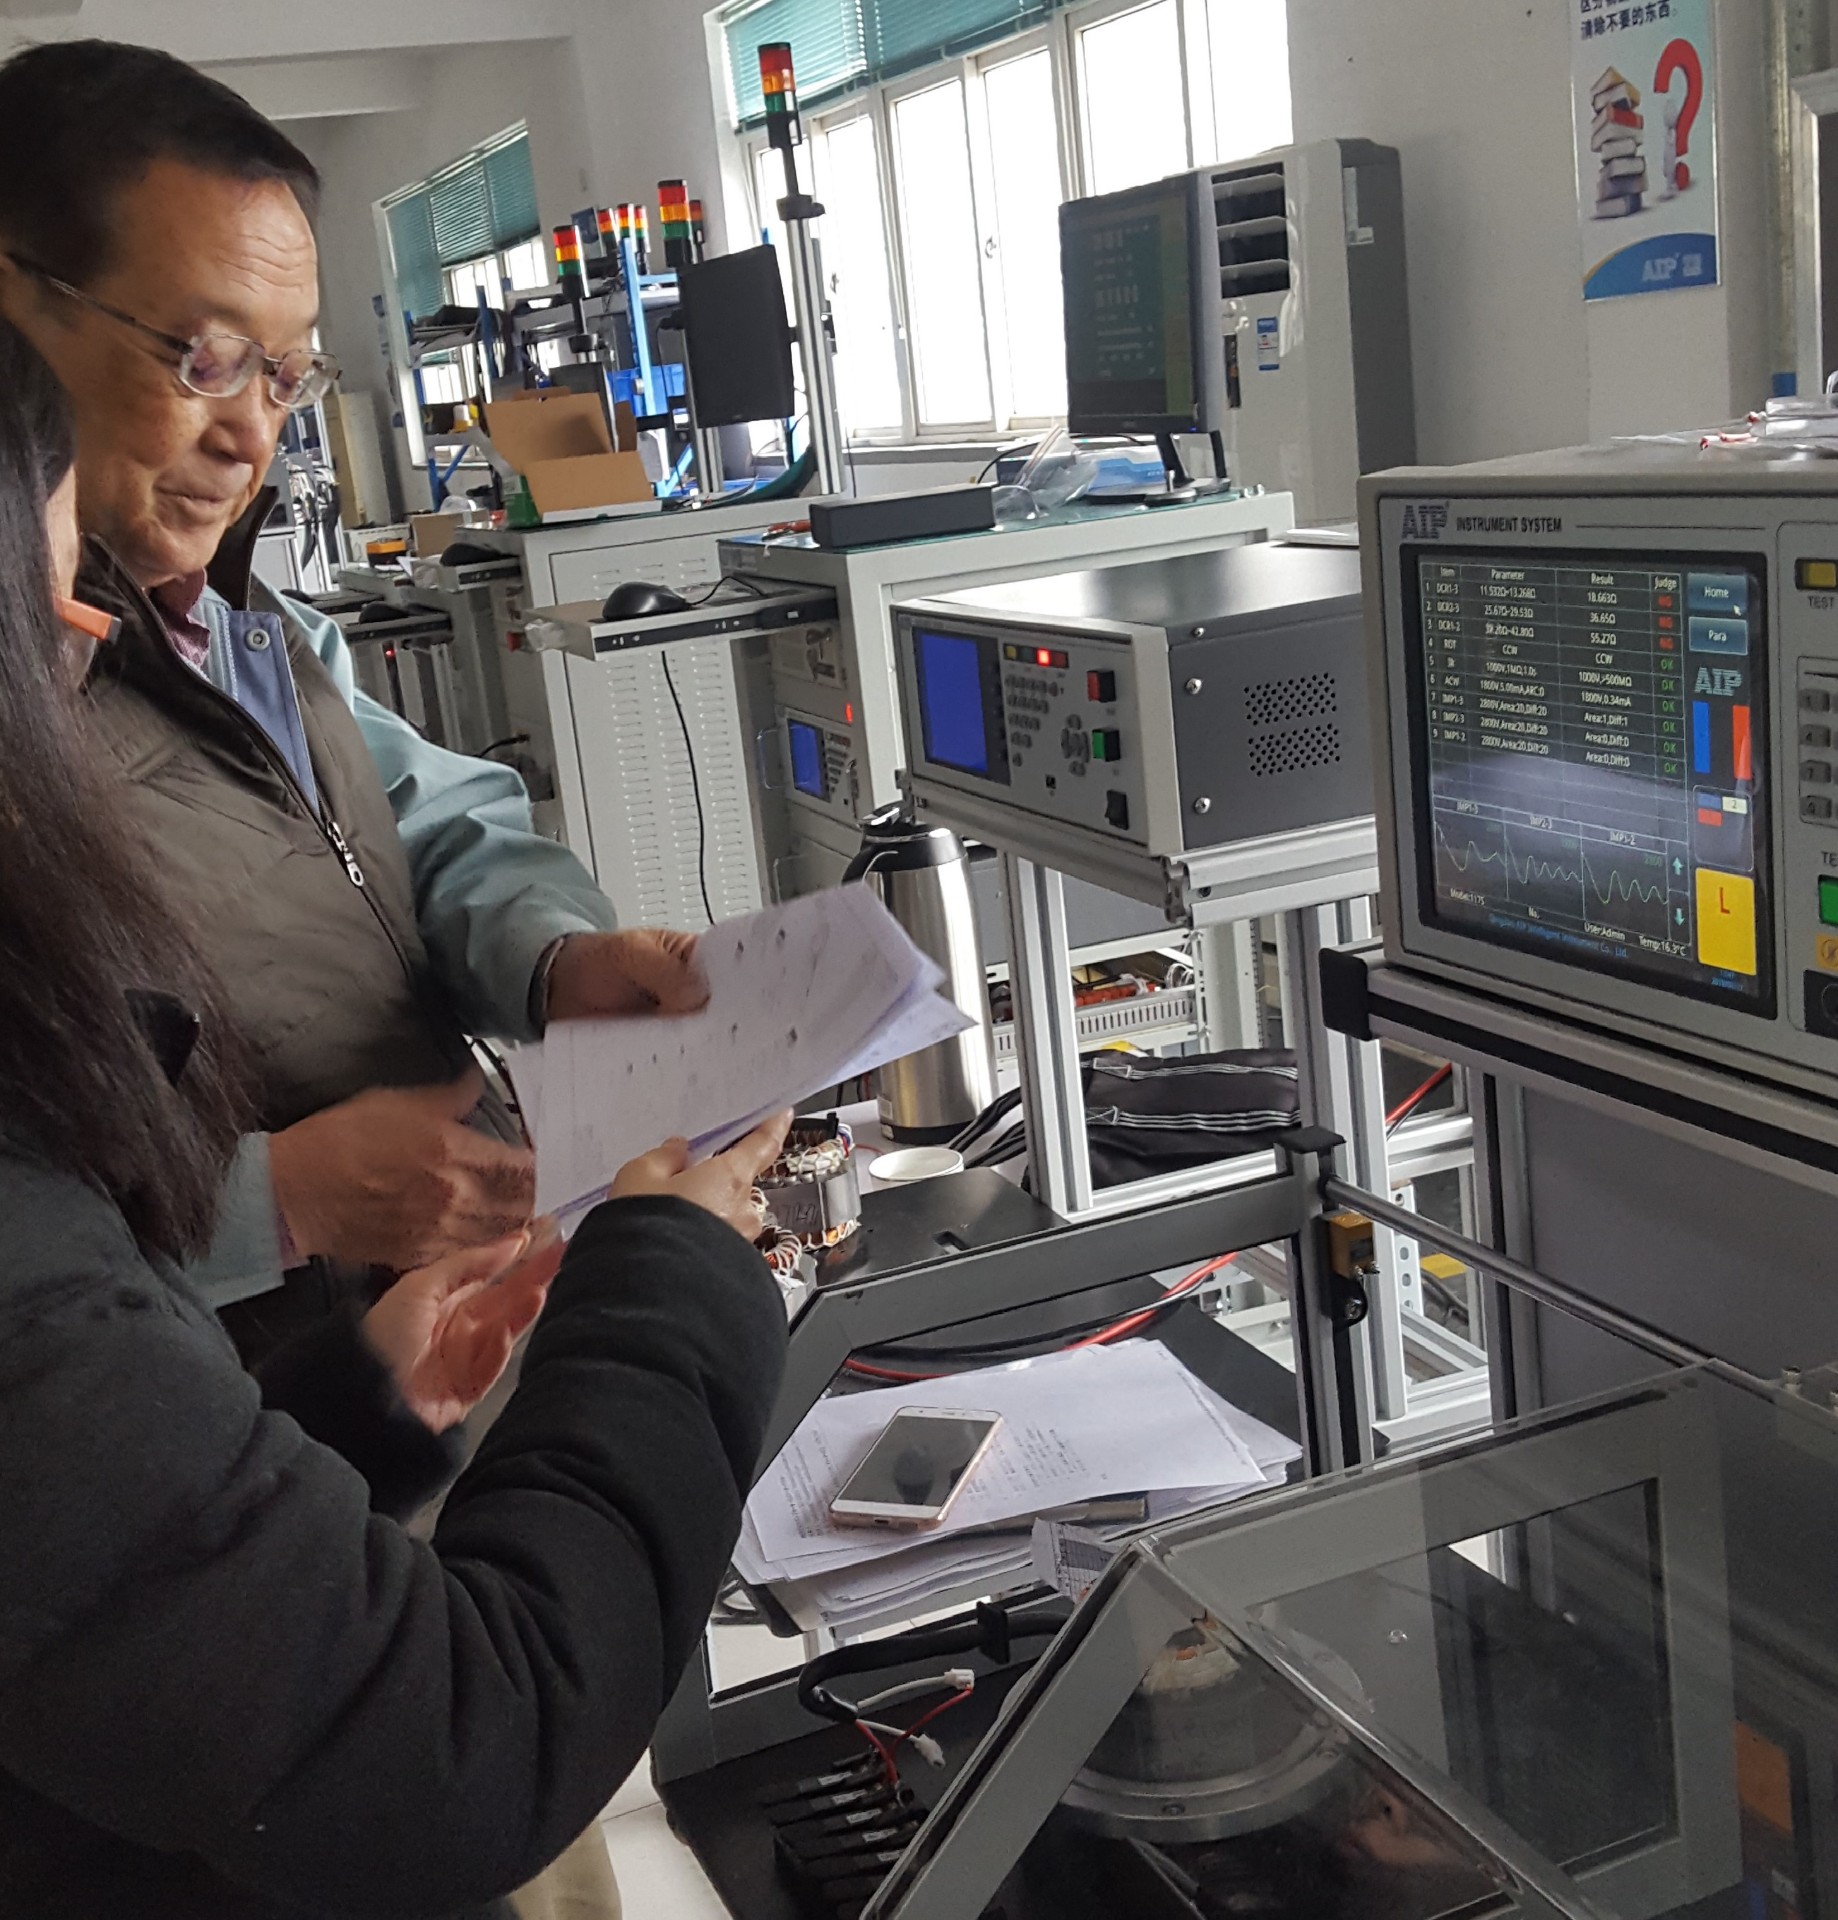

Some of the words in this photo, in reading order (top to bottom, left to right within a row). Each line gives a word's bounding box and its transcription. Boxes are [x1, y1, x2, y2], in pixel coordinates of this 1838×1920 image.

[1401, 504, 1448, 539] AIP
[1456, 516, 1518, 532] INSTRUMENT
[1521, 517, 1562, 533] SYSTEM
[1440, 566, 1455, 577] Item
[1491, 569, 1525, 580] Parameter
[1591, 573, 1614, 585] Result
[1654, 576, 1677, 590] Judge
[1704, 586, 1729, 598] Home
[1807, 595, 1835, 610] TEST
[1590, 632, 1617, 646] 55.27Ω
[1708, 630, 1727, 642] Para
[1502, 644, 1518, 655] CCW
[1595, 653, 1613, 665] CCW
[1660, 659, 1674, 671] OK
[1661, 680, 1675, 692] OK
[1694, 667, 1742, 697] AIP
[1662, 700, 1676, 713] OK
[1662, 721, 1676, 733] OK
[1663, 741, 1677, 754] OK
[1664, 762, 1678, 774] OK
[1719, 886, 1730, 914] L
